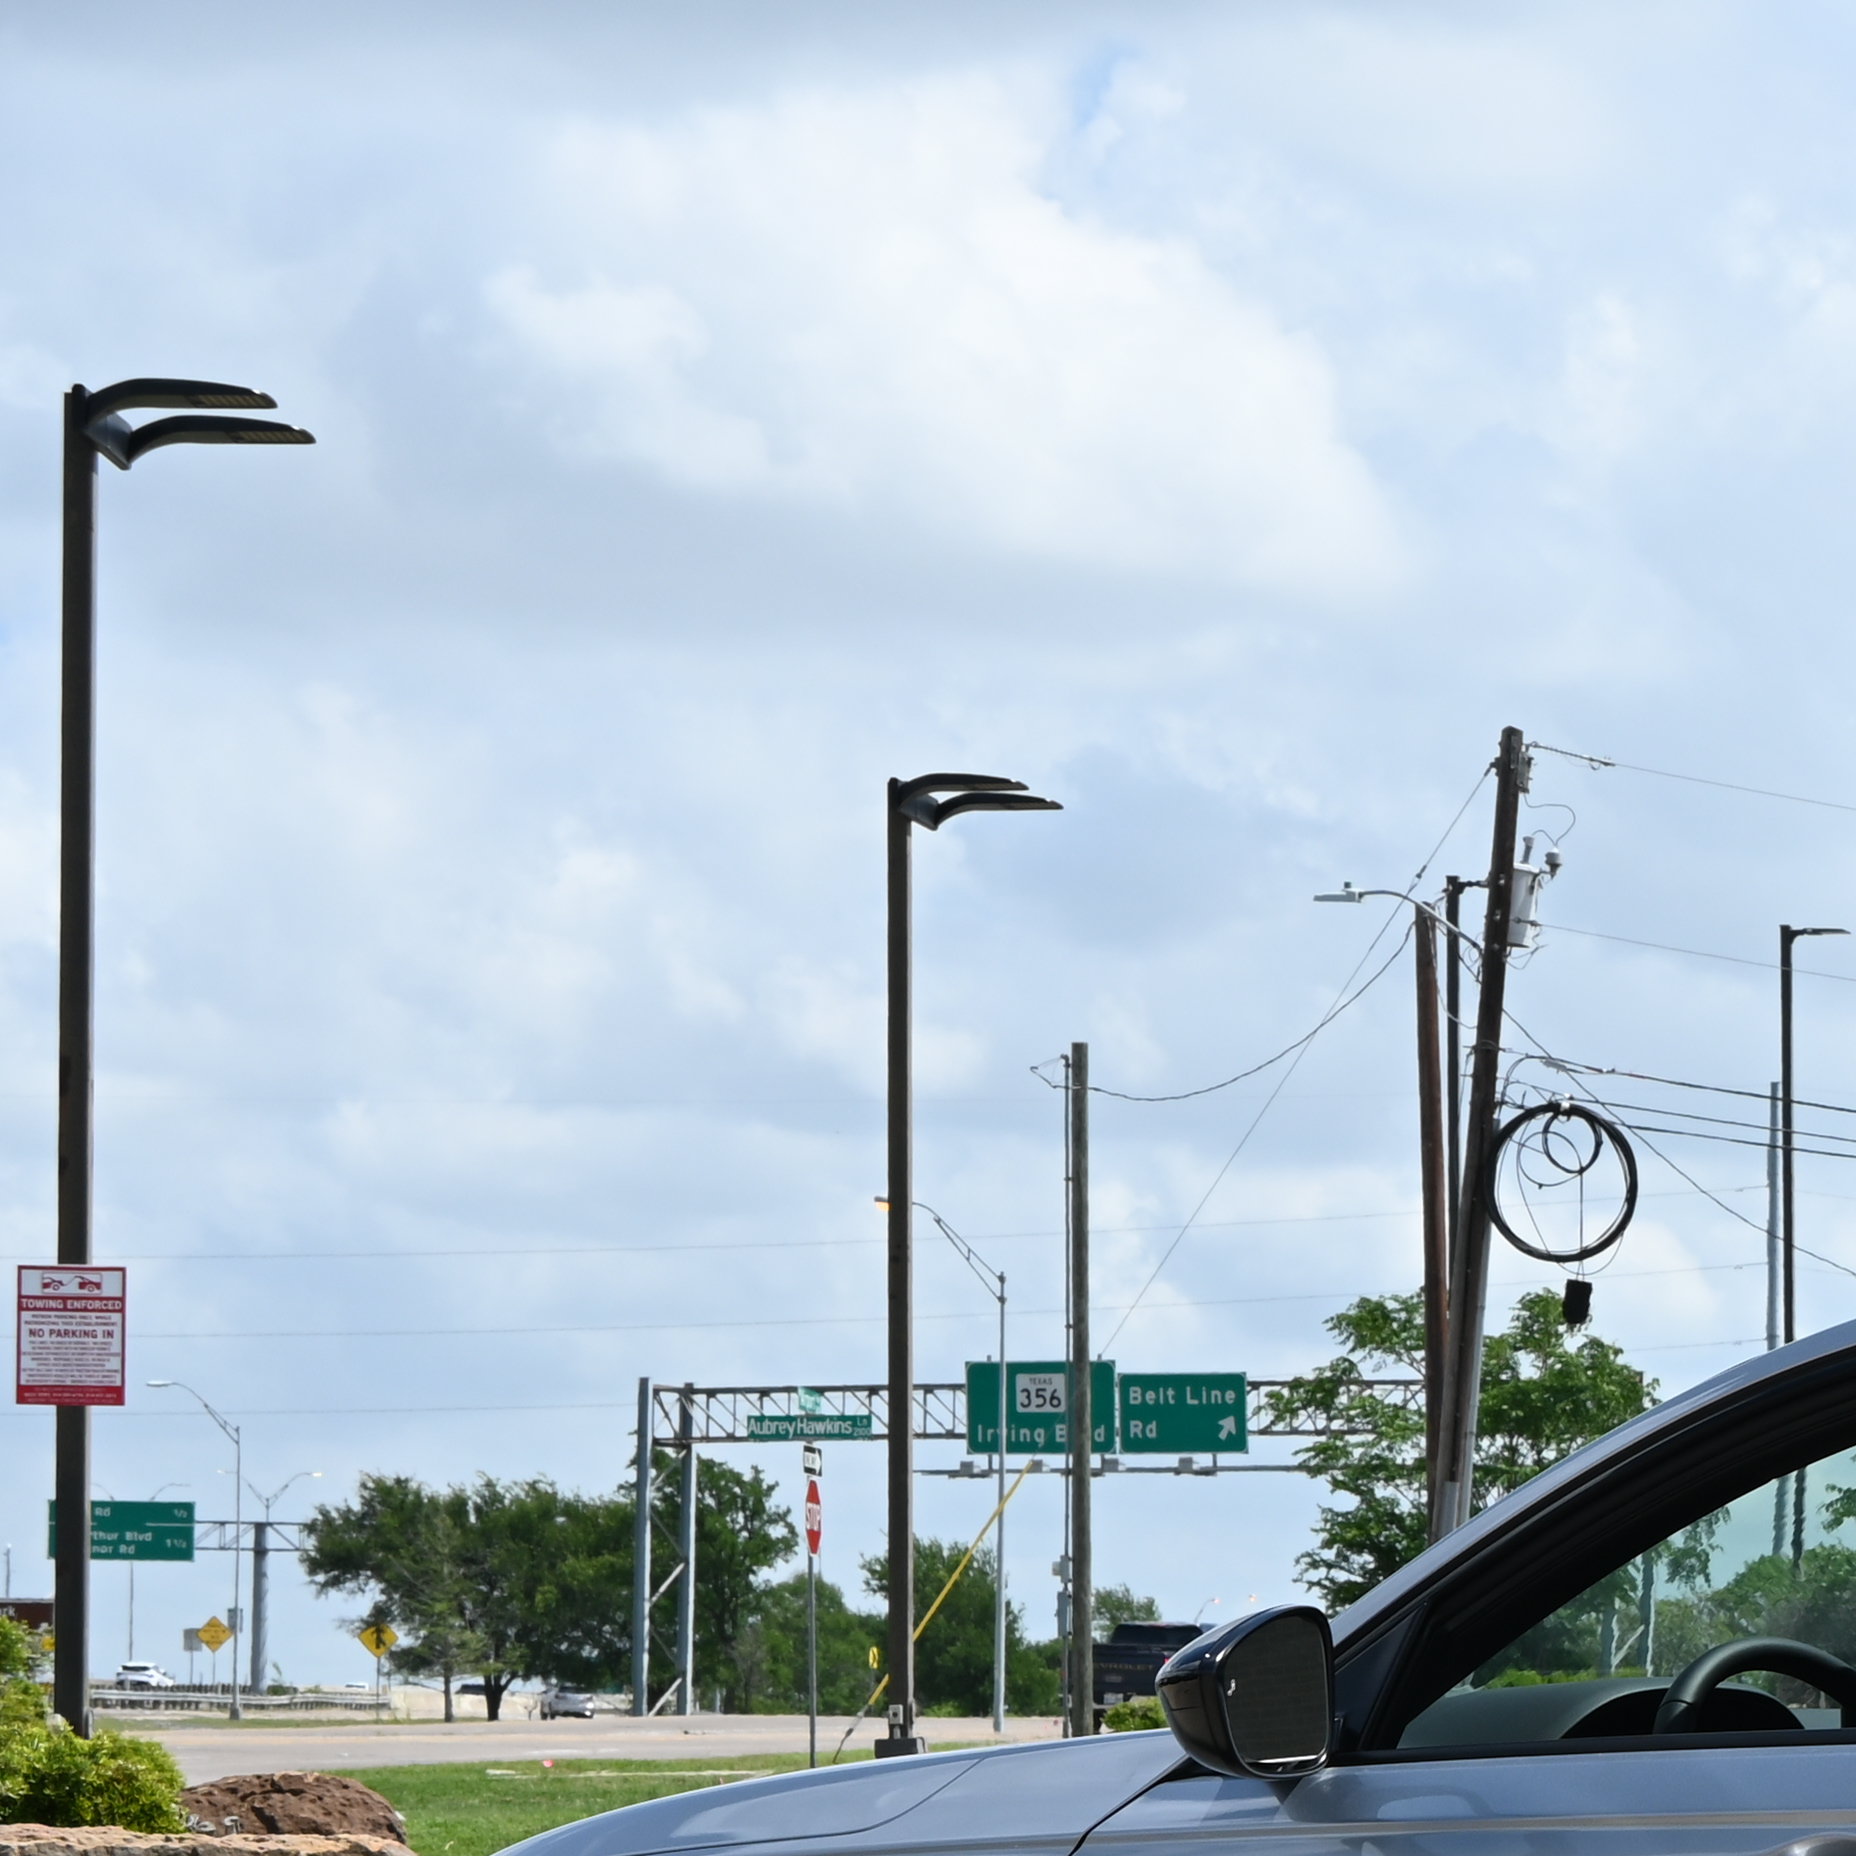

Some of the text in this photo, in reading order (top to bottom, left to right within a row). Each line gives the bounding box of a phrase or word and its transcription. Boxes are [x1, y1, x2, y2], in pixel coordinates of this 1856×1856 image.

[21, 1299, 122, 1310] TOWING ENFORCED
[28, 1328, 115, 1339] NO PARKING IN
[1029, 1377, 1053, 1386] TEXAS
[1019, 1388, 1062, 1409] 356
[1128, 1386, 1236, 1405] Belt Line
[748, 1417, 796, 1438] Aubrey
[797, 1416, 853, 1435] Hawkins
[1129, 1420, 1158, 1439] Rd
[977, 1424, 1045, 1448] Iring
[94, 1506, 111, 1517] Rd
[806, 1503, 821, 1532] STOP
[125, 1531, 153, 1542] Blvd
[119, 1544, 136, 1554] Rd
